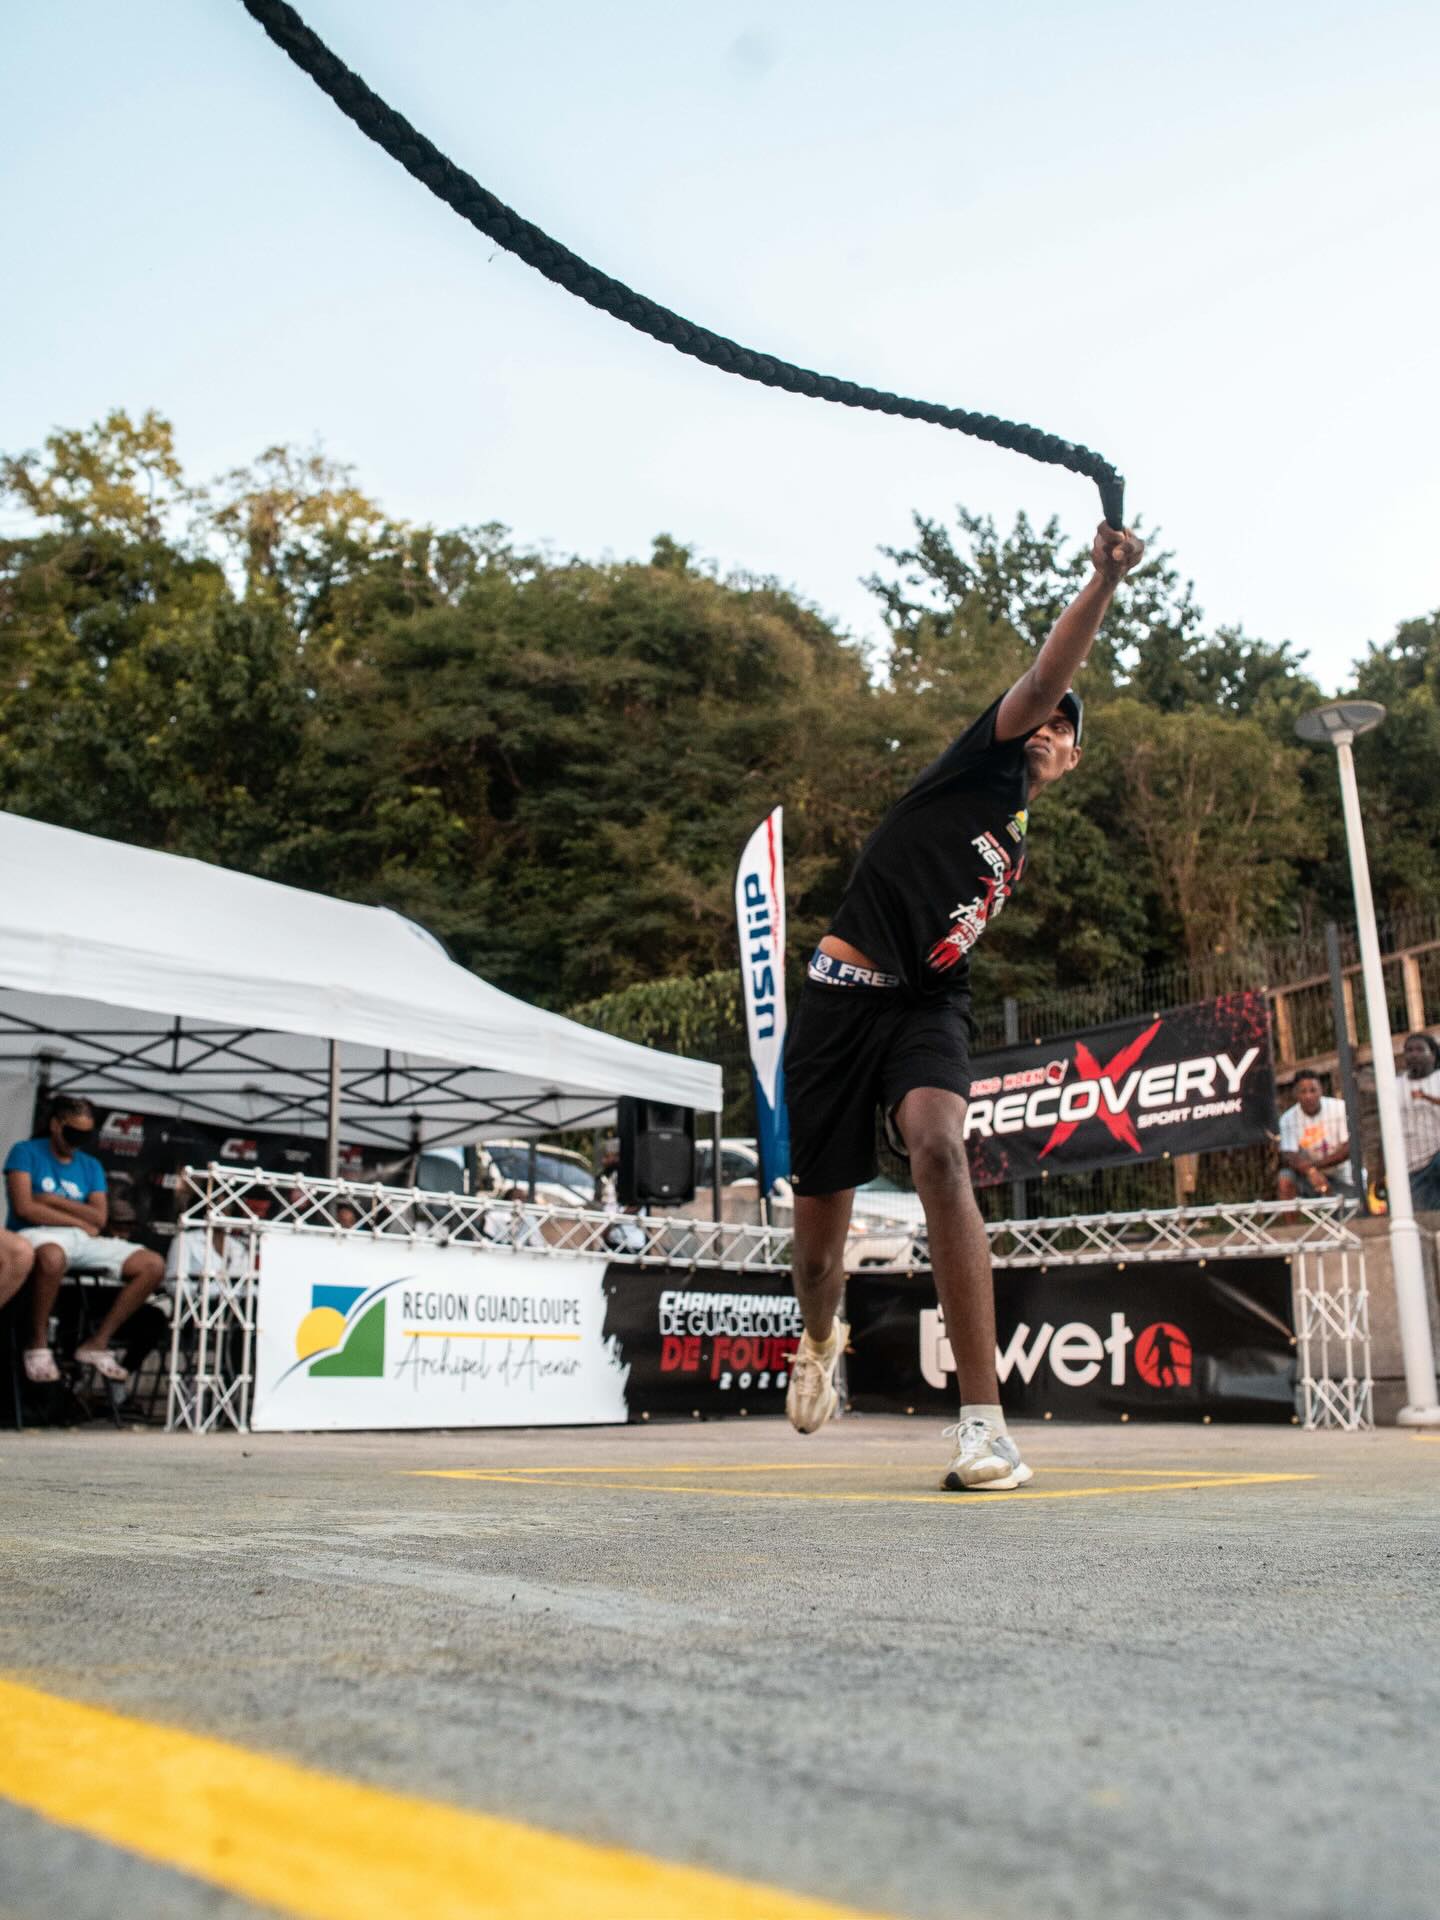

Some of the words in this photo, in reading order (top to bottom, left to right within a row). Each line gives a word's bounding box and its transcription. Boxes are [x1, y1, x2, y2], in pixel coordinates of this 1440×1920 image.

[963, 1047, 1260, 1140] RECOVERY
[1137, 1106, 1191, 1129] SPORT
[1192, 1098, 1242, 1120] DRINK
[402, 1291, 469, 1320] REGION
[475, 1294, 581, 1326] GUADELOUPE
[659, 1310, 687, 1336] DE
[687, 1311, 804, 1337] GUADELOUPE
[394, 1333, 490, 1392] Archipel
[660, 1335, 701, 1372] DE
